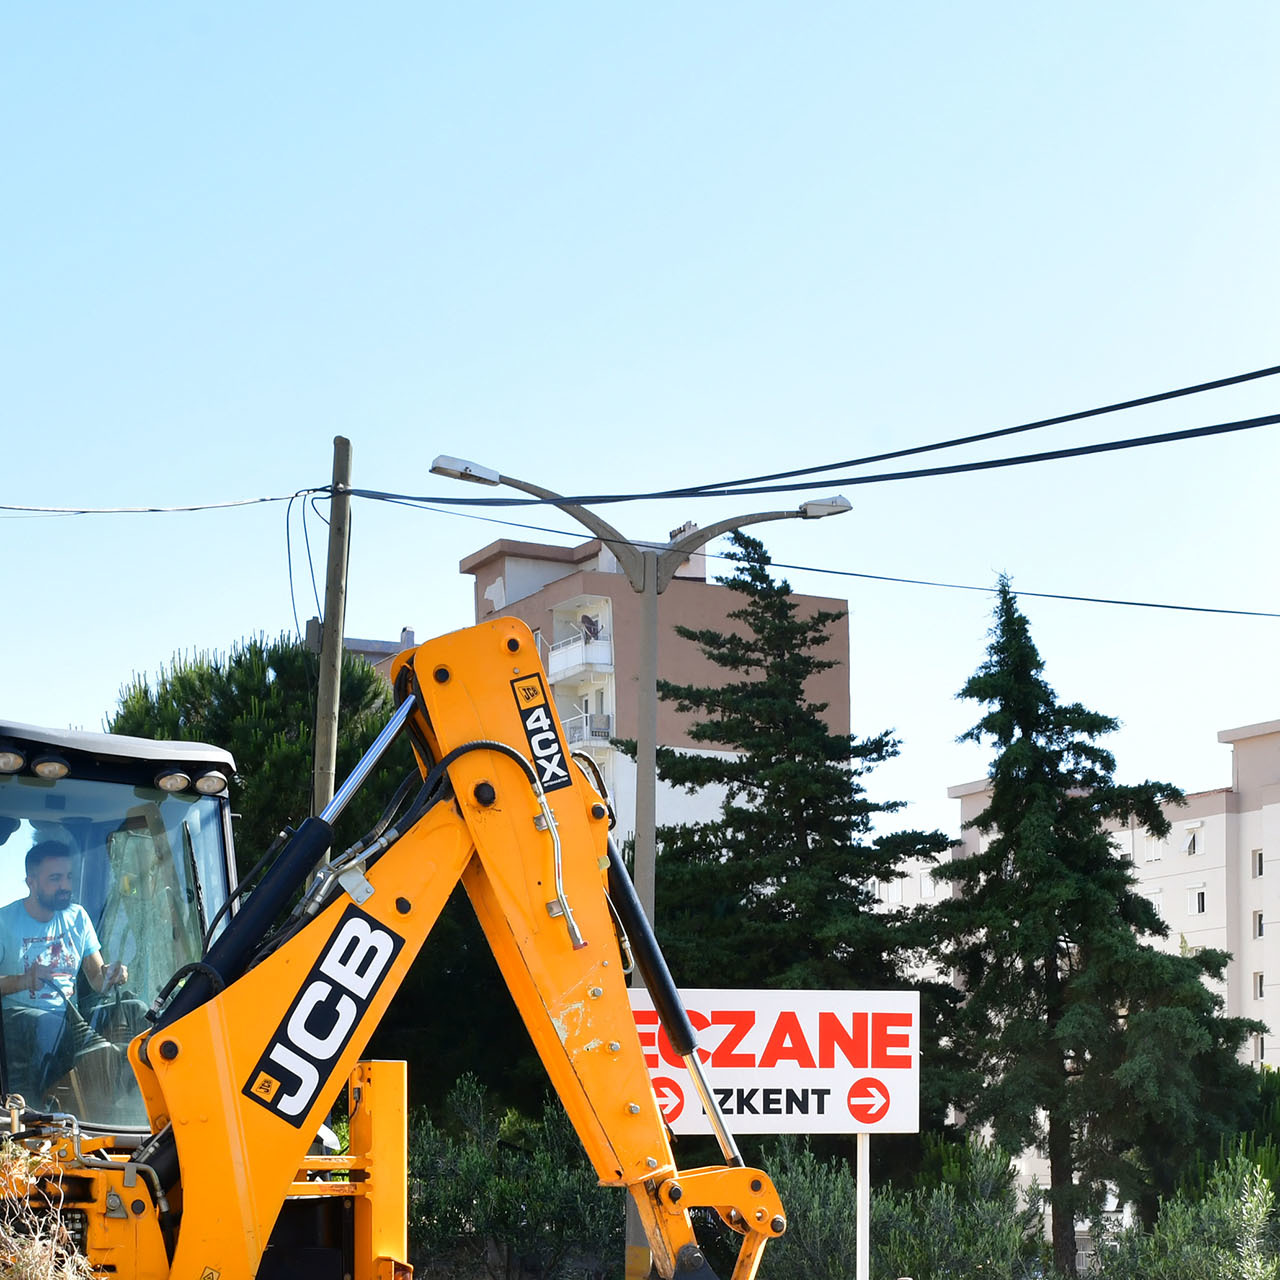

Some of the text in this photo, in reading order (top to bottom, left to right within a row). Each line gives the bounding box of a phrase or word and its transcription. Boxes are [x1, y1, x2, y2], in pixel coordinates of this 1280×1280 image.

[522, 687, 538, 701] JCB
[525, 707, 568, 782] 4CX
[269, 917, 394, 1116] JCB
[702, 1088, 831, 1115] ZKENT
